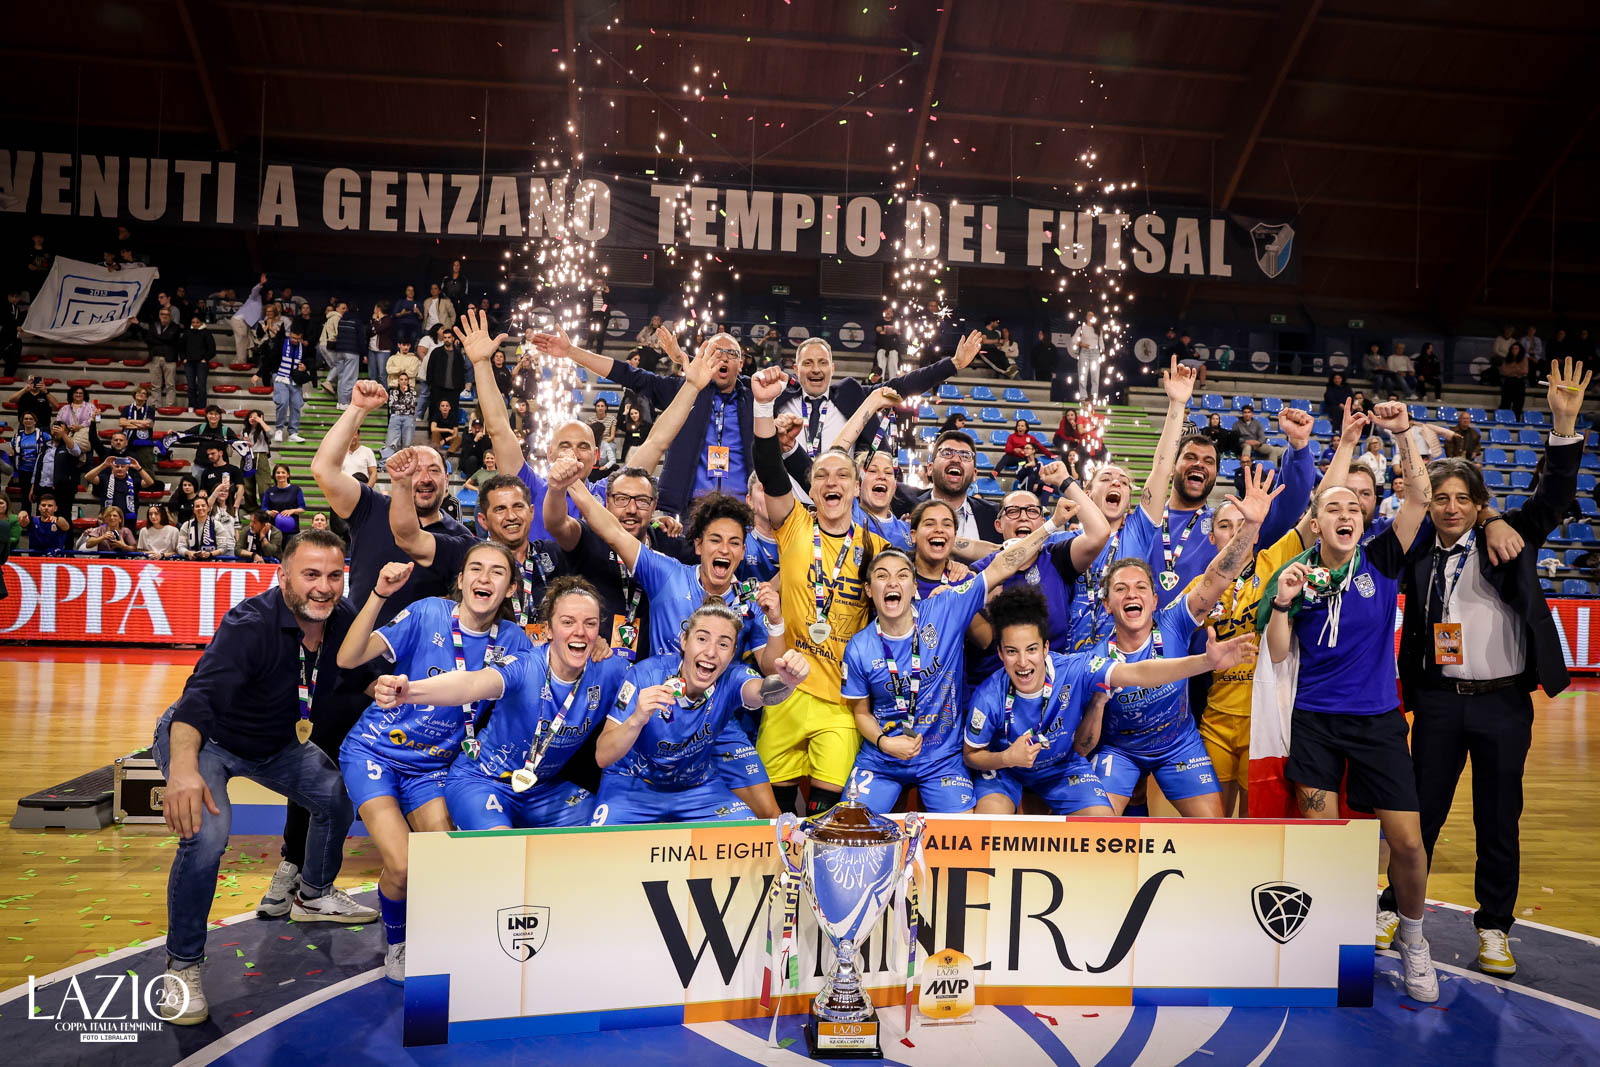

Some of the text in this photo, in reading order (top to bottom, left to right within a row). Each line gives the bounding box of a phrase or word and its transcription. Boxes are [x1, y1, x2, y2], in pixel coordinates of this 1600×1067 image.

[258, 164, 300, 228] A
[322, 167, 611, 242] GENZANO
[650, 184, 882, 257] TEMPIO
[903, 201, 1005, 264] DEL
[1027, 208, 1232, 277] FUTSAL
[366, 759, 383, 780] 5
[485, 794, 504, 813] 4
[591, 803, 609, 826] 9
[650, 845, 709, 863] FINAL
[715, 841, 774, 862] EIGHT
[925, 834, 973, 852] ALIA
[981, 835, 1090, 853] FEMMINILE
[1162, 837, 1176, 854] A
[508, 916, 539, 930] LND
[936, 968, 959, 976] LAZIO
[924, 979, 969, 995] MVP
[833, 1024, 862, 1034] LAZIO
